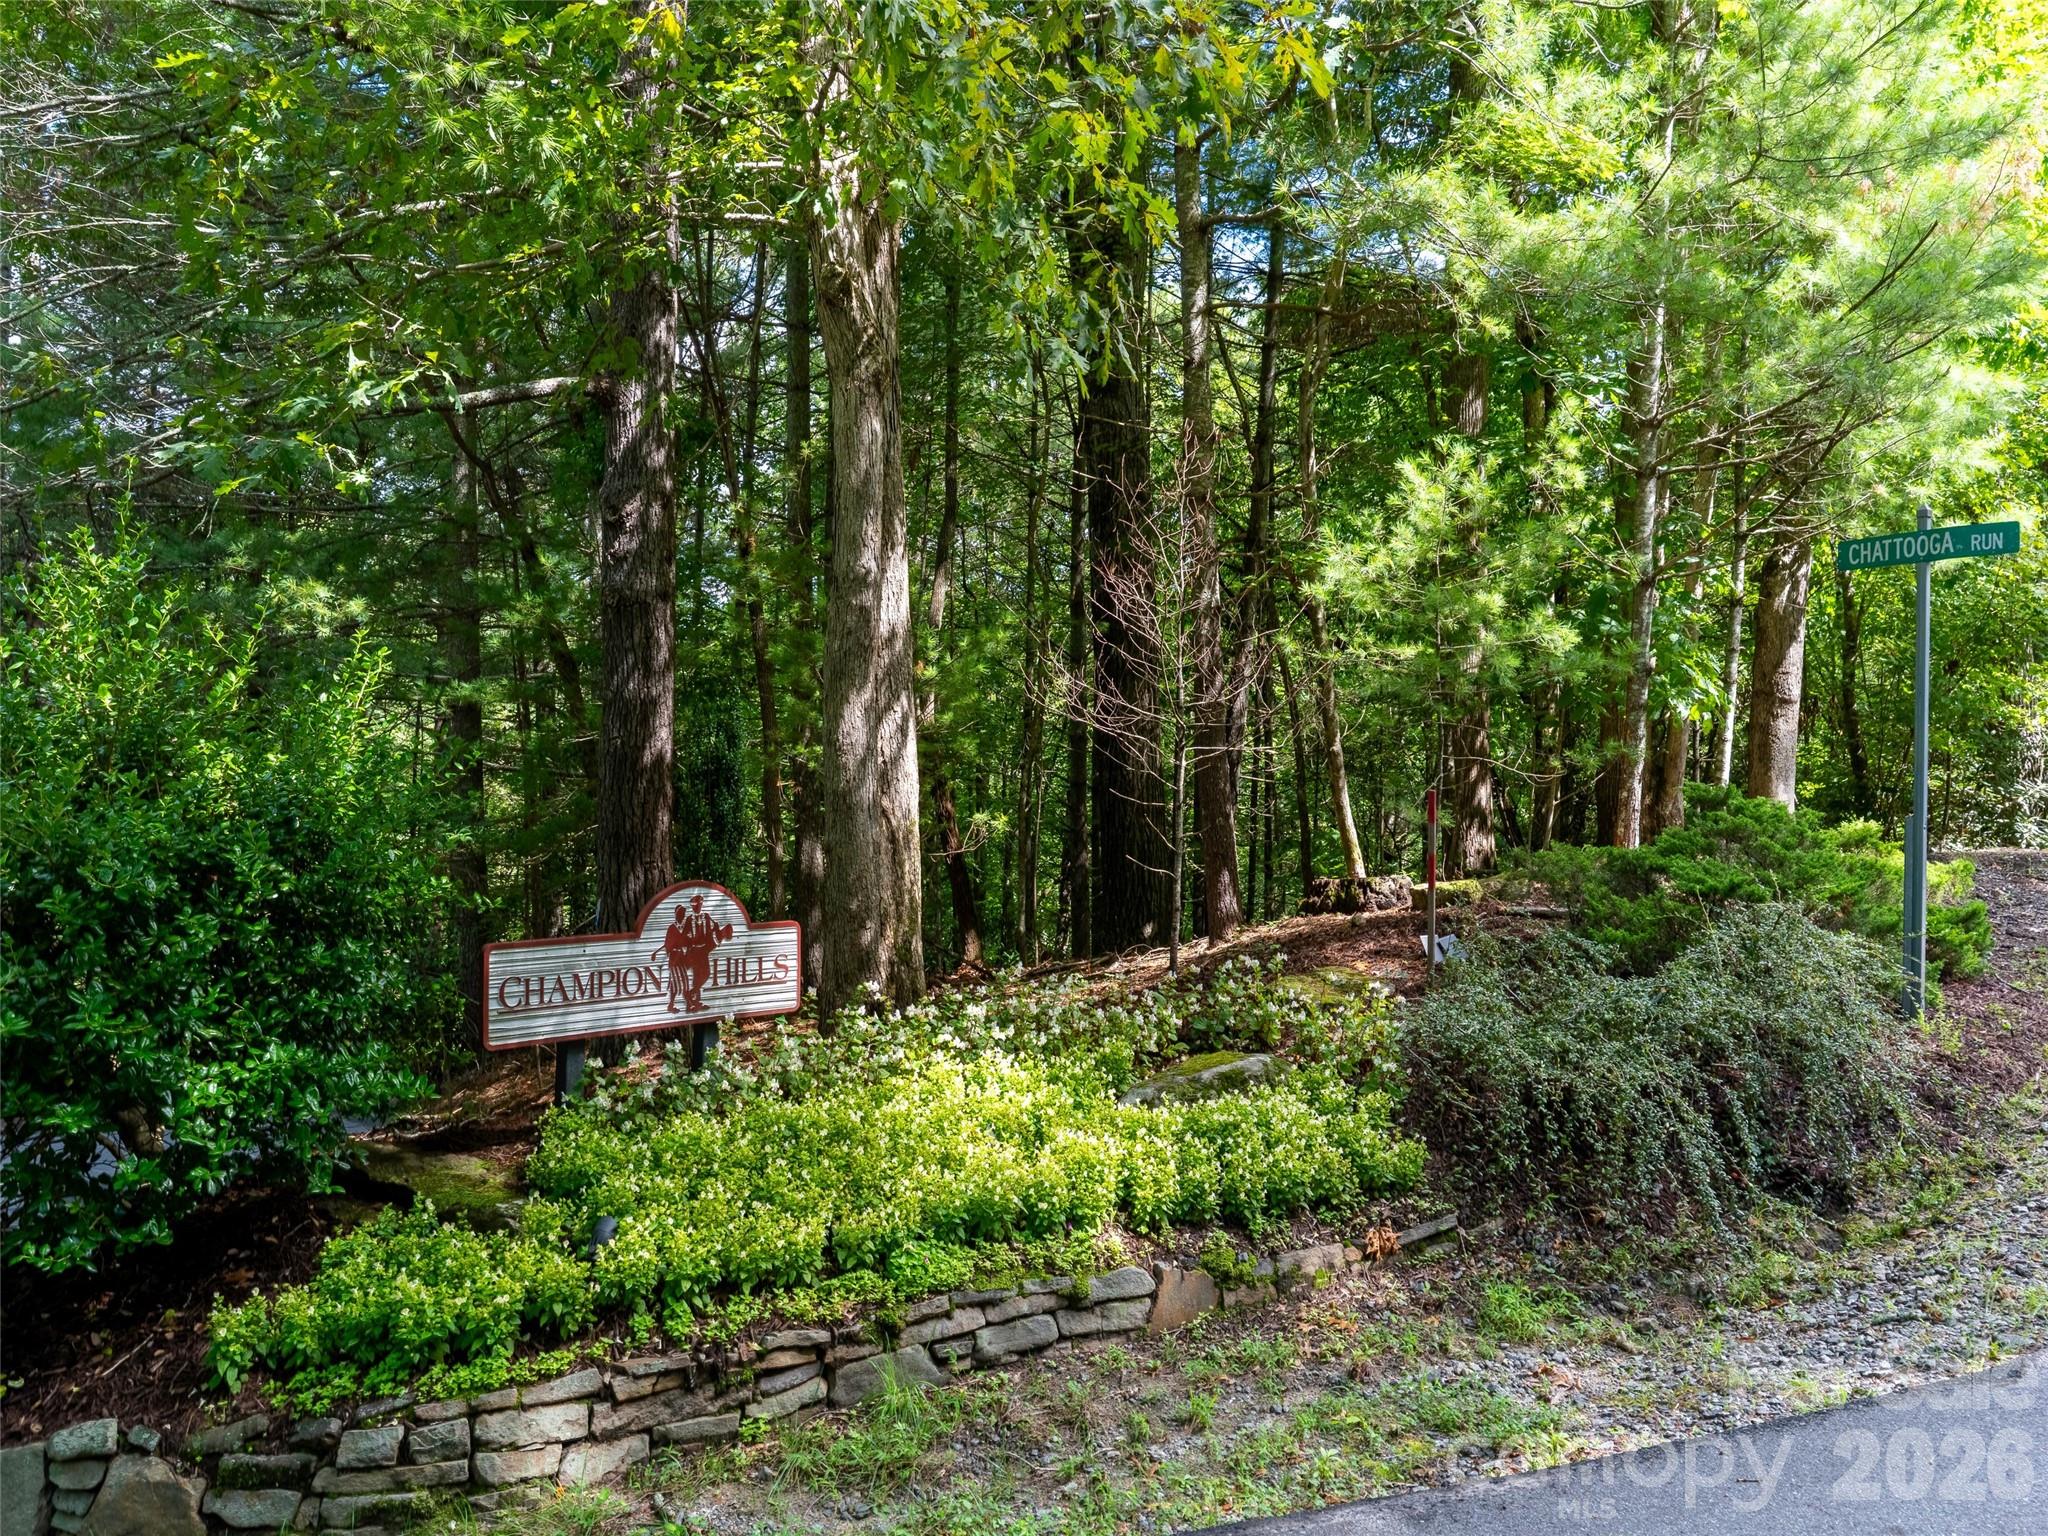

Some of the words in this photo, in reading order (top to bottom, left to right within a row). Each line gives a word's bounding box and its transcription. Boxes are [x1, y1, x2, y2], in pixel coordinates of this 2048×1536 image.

[1848, 531, 1954, 565] CHATTOOGA
[1970, 532, 2004, 551] RUN
[498, 963, 665, 1010] CHAMPION
[711, 953, 789, 987] HILLS
